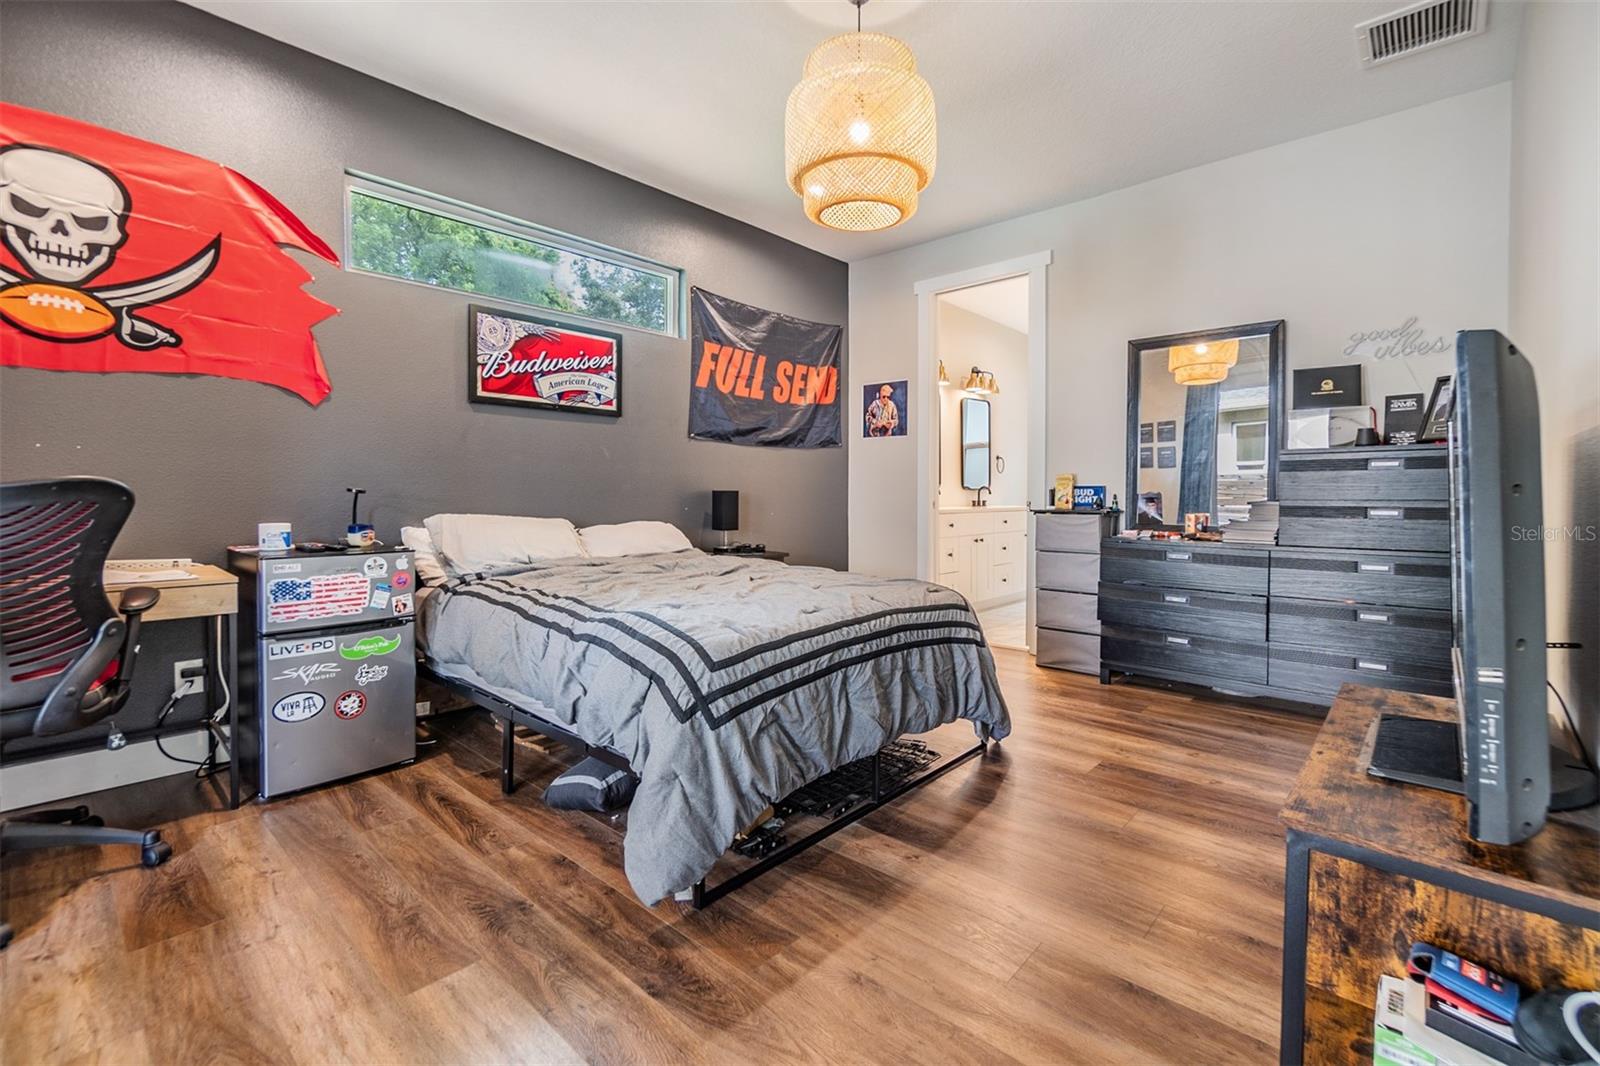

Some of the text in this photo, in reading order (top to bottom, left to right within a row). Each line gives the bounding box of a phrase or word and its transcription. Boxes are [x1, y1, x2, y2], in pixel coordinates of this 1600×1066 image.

[1344, 316, 1451, 359] good vibes
[482, 350, 612, 378] Budweiser
[695, 340, 838, 405] FULL SEND
[548, 377, 609, 391] American Lager
[1074, 488, 1095, 496] BUD
[1074, 495, 1099, 503] IGHT
[270, 639, 334, 656] LIVE PD
[272, 662, 342, 685] SKAR
[280, 701, 301, 711] VIVA
